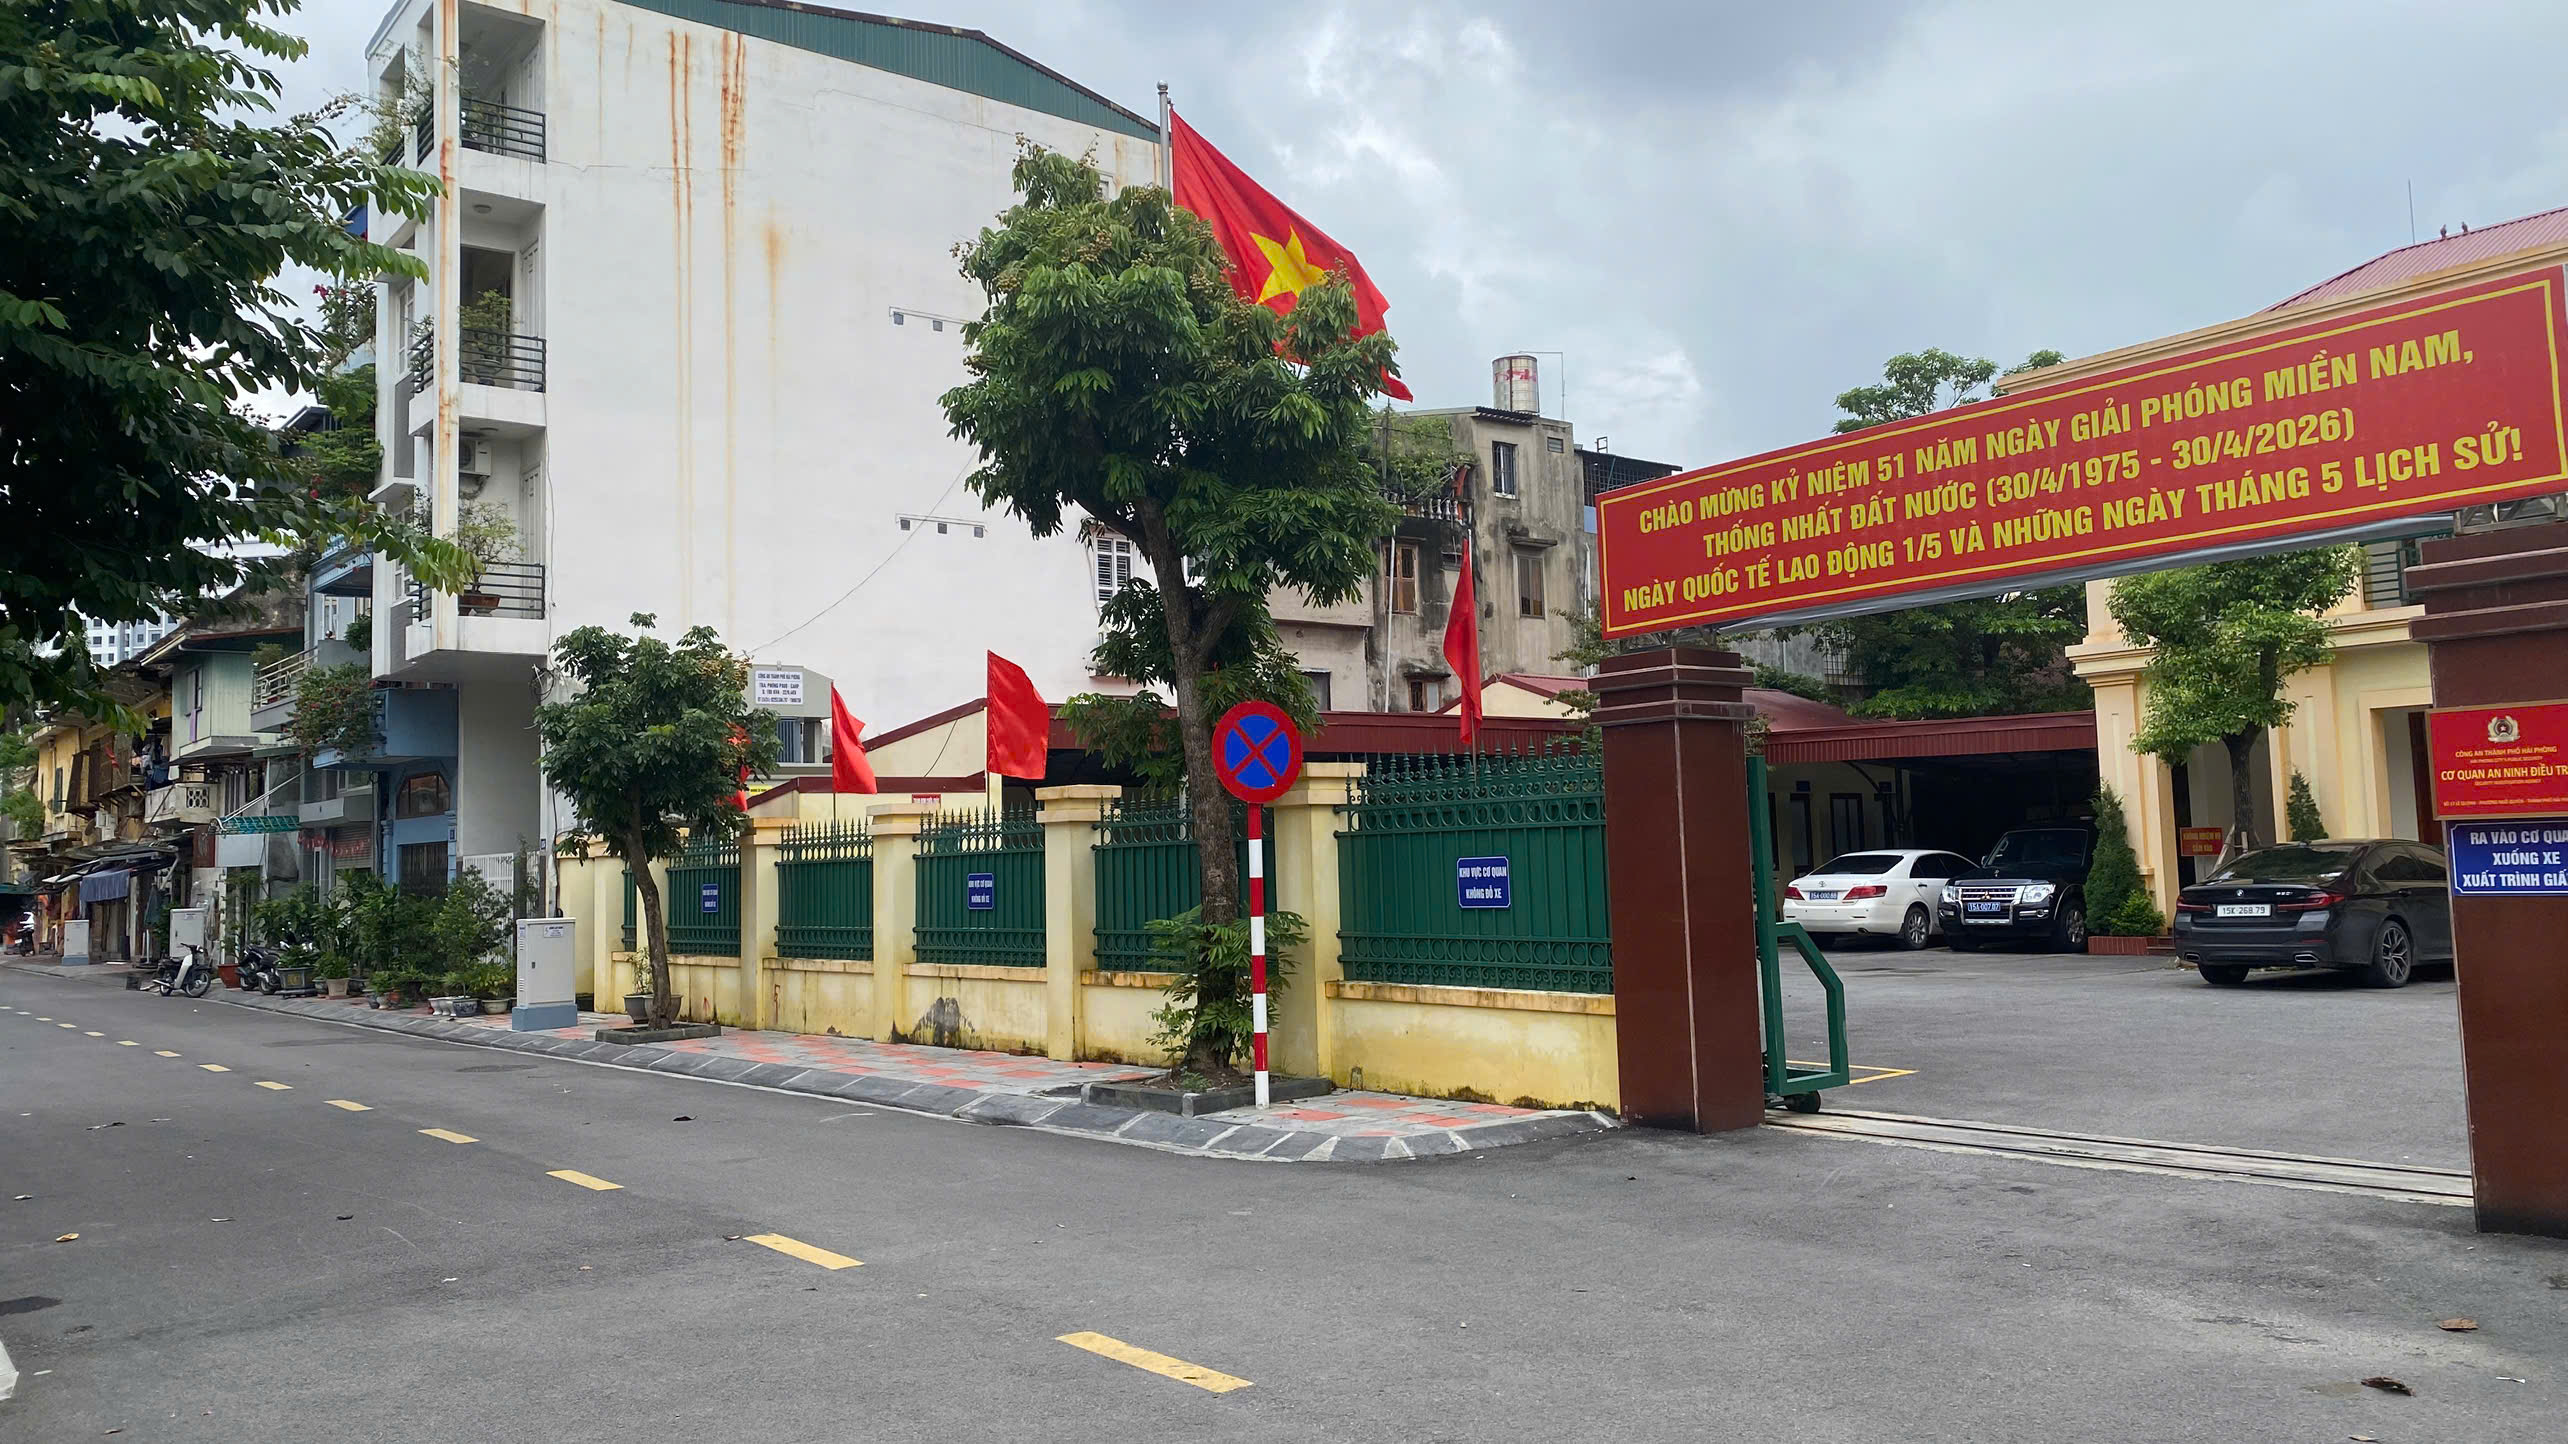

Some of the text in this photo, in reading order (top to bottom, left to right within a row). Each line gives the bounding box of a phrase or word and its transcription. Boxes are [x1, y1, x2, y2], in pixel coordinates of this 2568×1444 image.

[1640, 329, 2473, 533] CHÀO MỪNG KỶ NIỆM 51 NĂM NGÀY GIẢI PHÓNG MIỀN NAM,
[1704, 519, 1775, 558] THỐNG
[1782, 500, 1843, 542] NHẤT
[1850, 490, 1896, 529] ĐẤT
[1905, 476, 1977, 520] NƯỚC
[1987, 450, 2140, 507] (30/4/1975
[2172, 407, 2355, 470] 30/4/2026)
[1624, 420, 2523, 612] NGÀY QUỐC TẾ LAO ĐỘNG 1/5 VÀ NHỮNG NGÀY THÁNG 5 LỊCH SỬ!
[2455, 750, 2473, 758] CÔNG
[2507, 747, 2520, 755] PHỐ
[2441, 762, 2568, 781] CƠ QUAN AN NINH ĐIỀU TR
[2470, 829, 2568, 844] RA VÀO CƠ QUA
[2492, 847, 2561, 865] XUỐNG XE
[1491, 866, 1507, 878] QUAN
[2462, 868, 2568, 887] XUẤT TRÌNH GIẤ
[1493, 887, 1502, 899] XE
